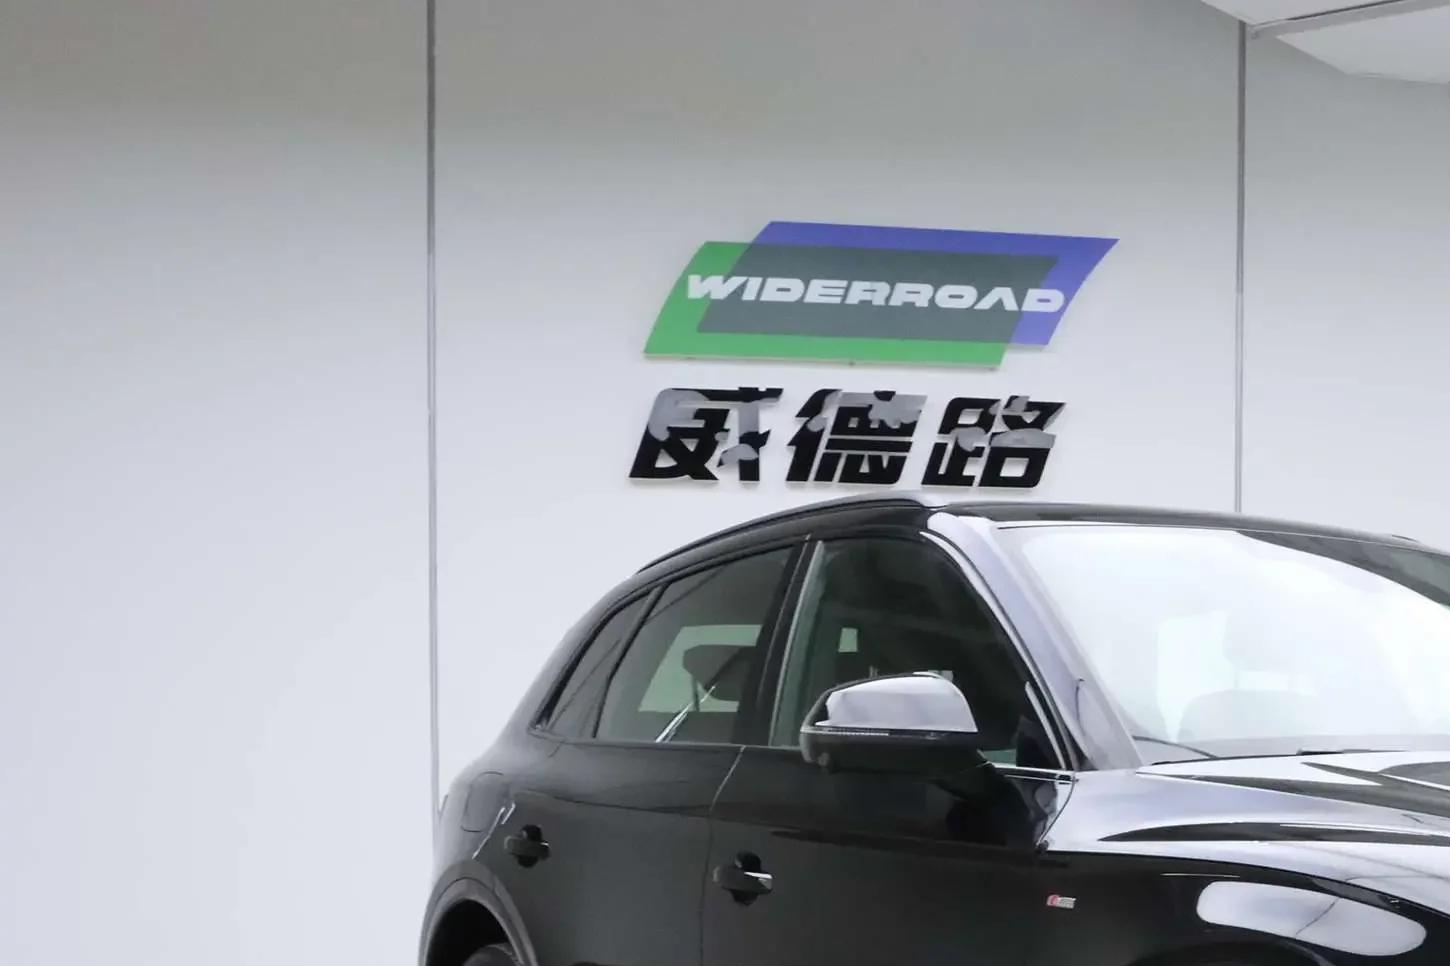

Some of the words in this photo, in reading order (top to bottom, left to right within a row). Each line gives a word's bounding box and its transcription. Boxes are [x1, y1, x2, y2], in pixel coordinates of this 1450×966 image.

[687, 274, 1065, 313] WIDERROAD
[628, 387, 1067, 488] 威德路
